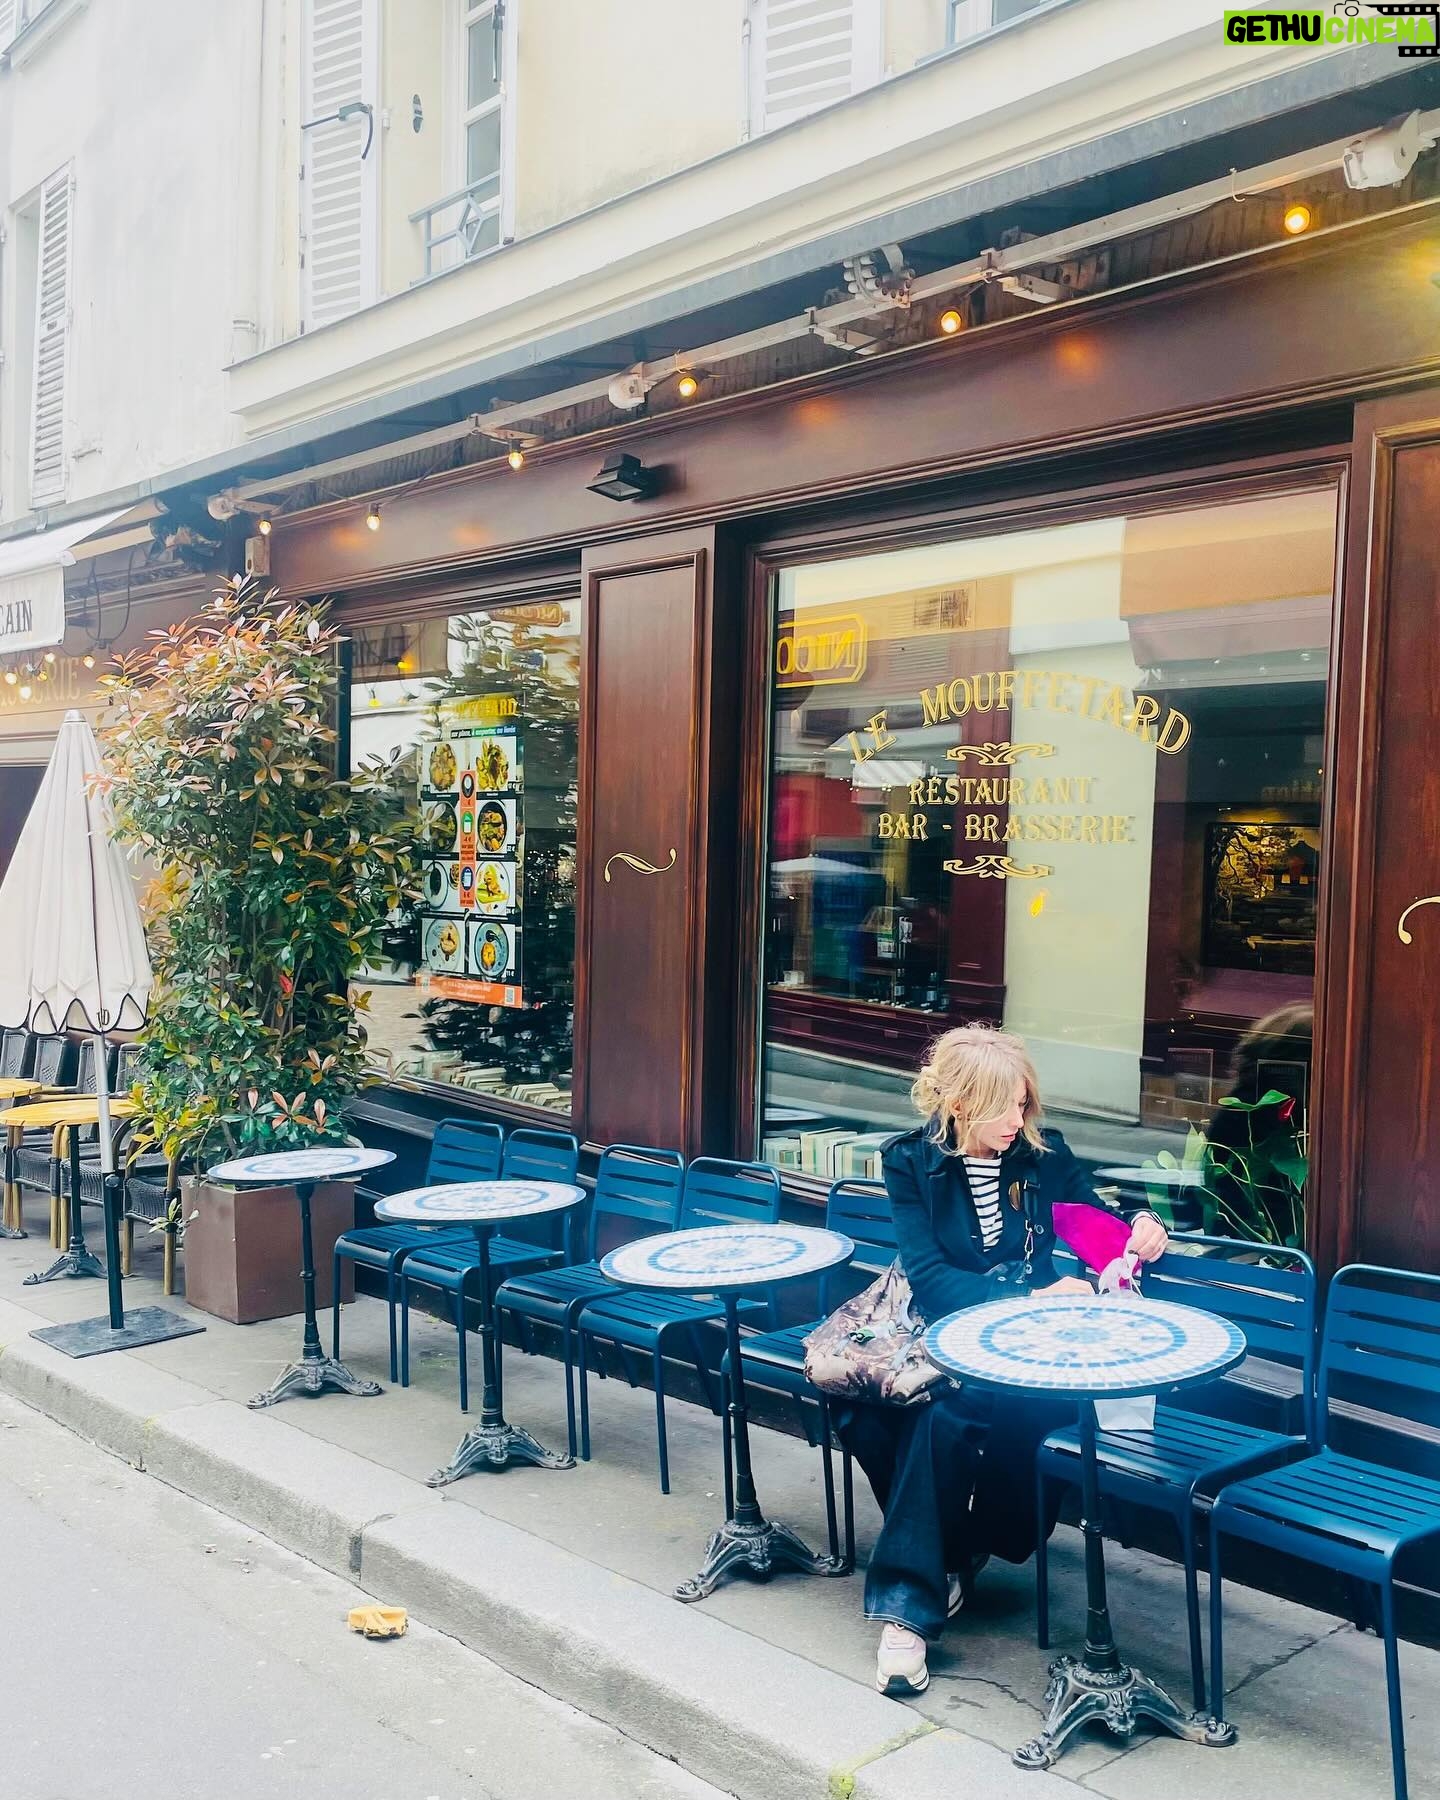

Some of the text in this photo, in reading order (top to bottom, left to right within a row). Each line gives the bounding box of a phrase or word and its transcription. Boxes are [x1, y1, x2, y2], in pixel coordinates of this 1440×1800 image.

[847, 670, 1192, 764] LE MOUFFETARD
[908, 776, 1097, 807] RESTAURANT
[878, 813, 929, 842] BAR
[964, 813, 1136, 845] BRASSERIE
